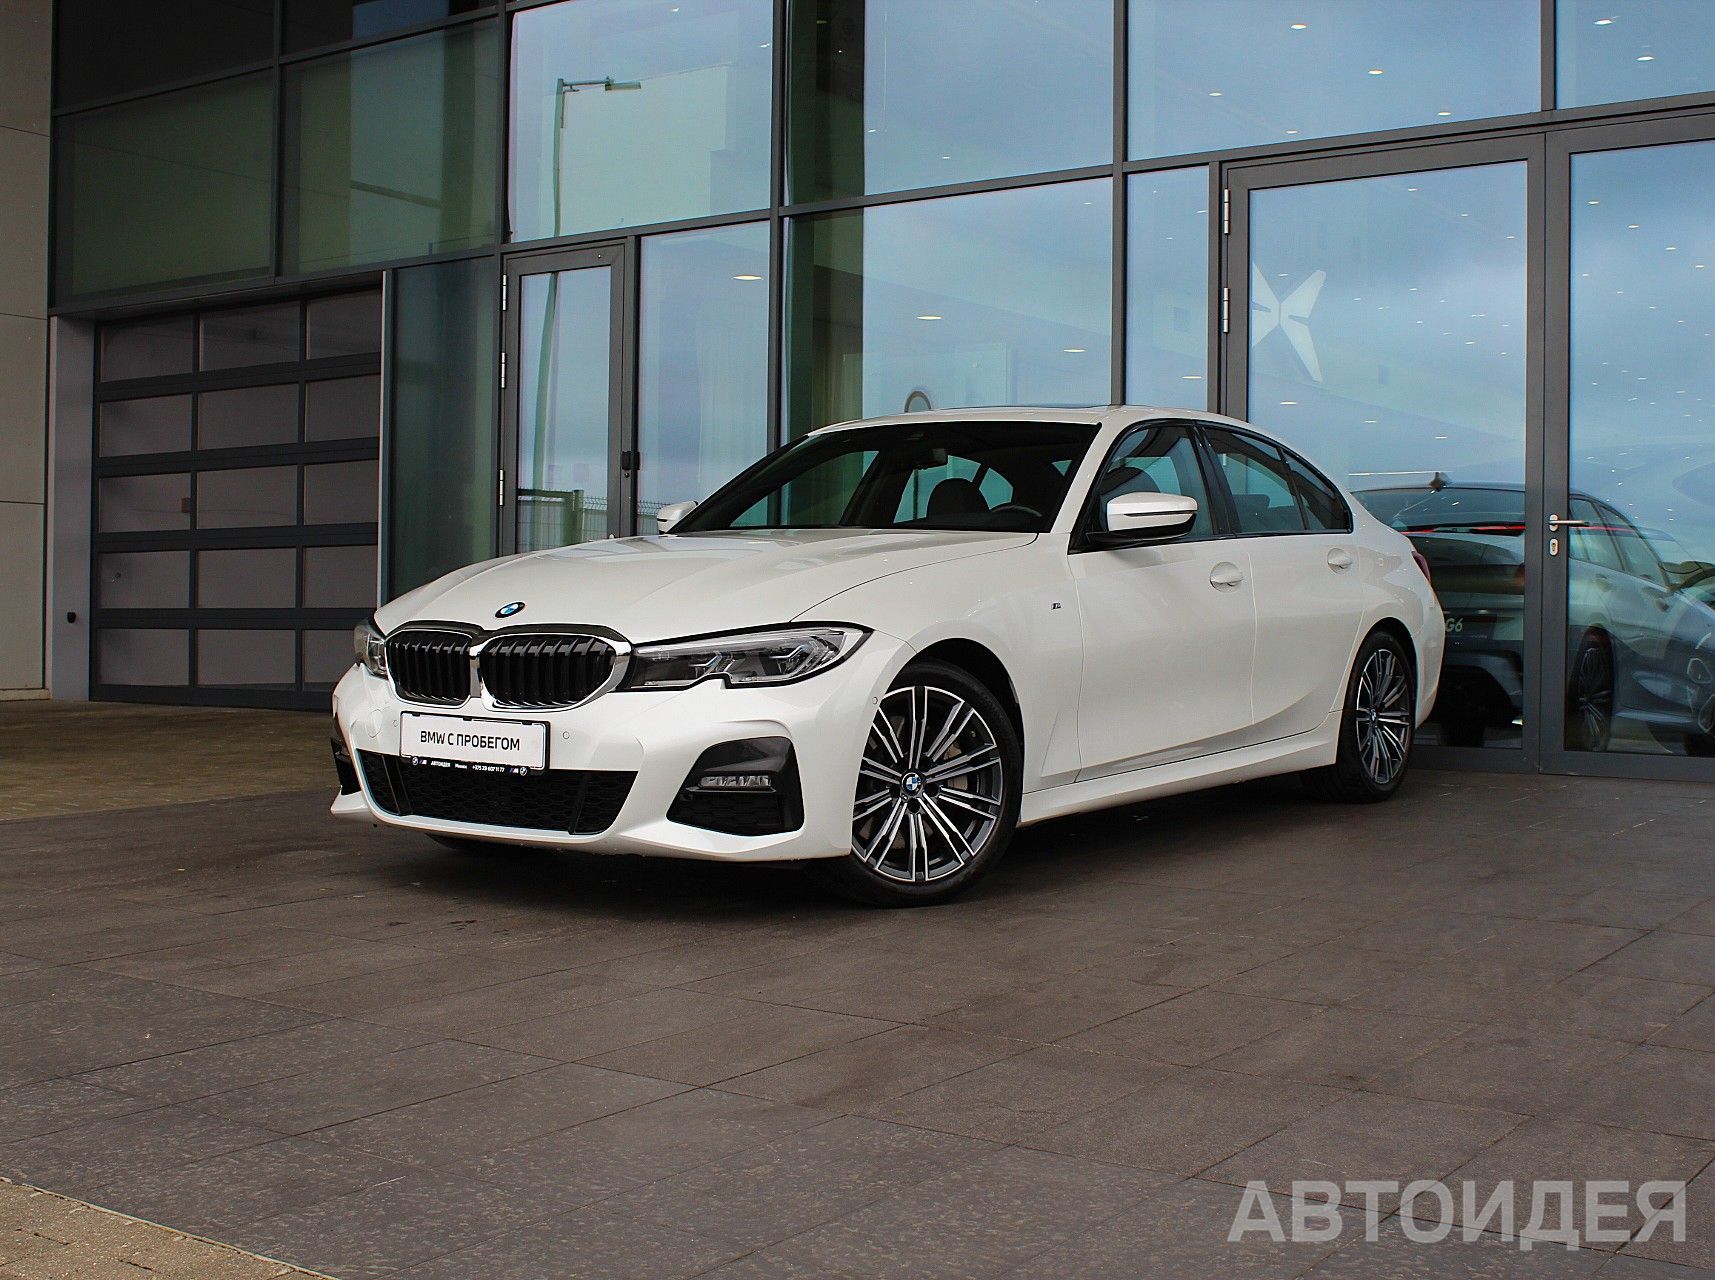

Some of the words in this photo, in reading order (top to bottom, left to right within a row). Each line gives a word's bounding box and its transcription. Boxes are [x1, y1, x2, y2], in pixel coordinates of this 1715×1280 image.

[420, 731, 446, 745] BMW
[447, 733, 454, 746] С
[456, 734, 520, 751] ПРОБЕГОМ
